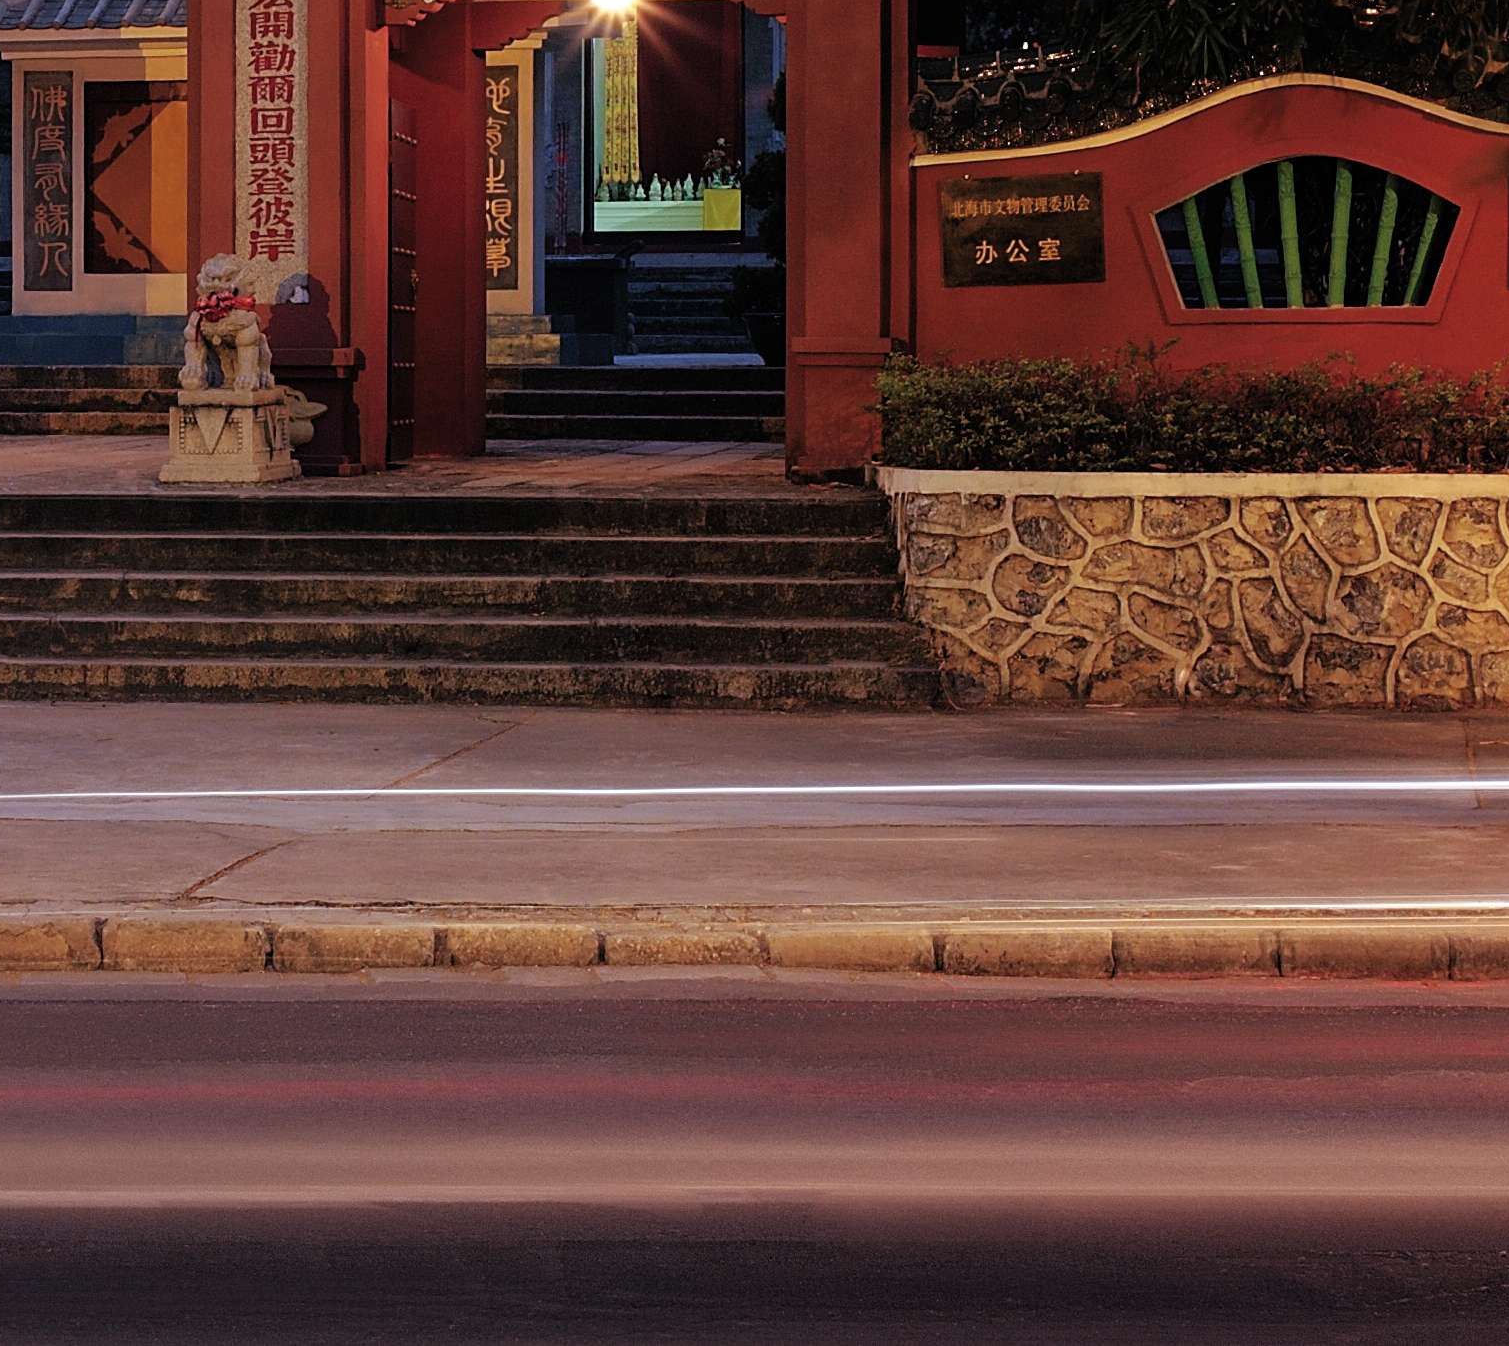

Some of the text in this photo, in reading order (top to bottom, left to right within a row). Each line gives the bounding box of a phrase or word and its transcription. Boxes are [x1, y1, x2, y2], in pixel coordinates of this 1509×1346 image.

[950, 194, 1091, 218] 北海市文物管理委员会
[974, 237, 1064, 265] 办公室
